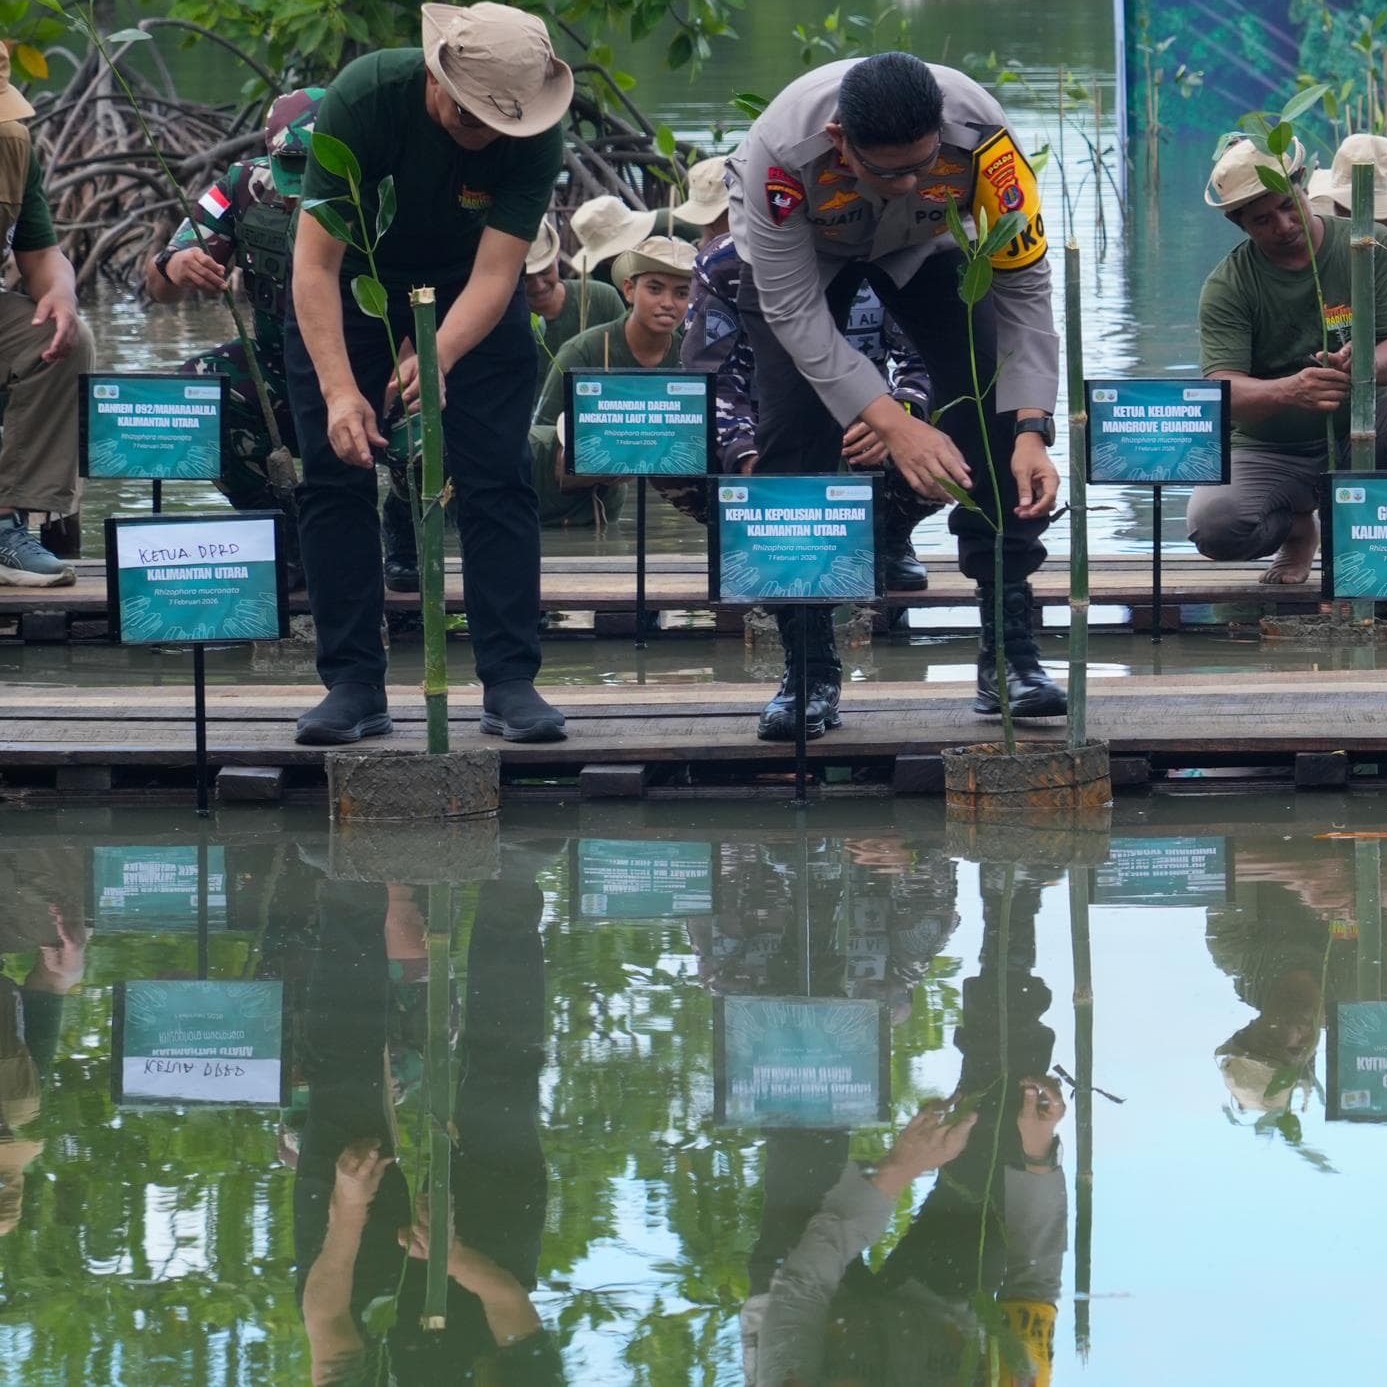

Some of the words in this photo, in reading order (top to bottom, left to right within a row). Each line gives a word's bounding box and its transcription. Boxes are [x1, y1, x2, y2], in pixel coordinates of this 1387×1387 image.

[98, 403, 133, 415] DANREM
[597, 400, 644, 411] KOMANDAN
[647, 400, 681, 411] DAERAH
[1113, 406, 1145, 417] KETUA
[1148, 406, 1202, 417] KELOMPOK
[117, 417, 170, 428] KALIMANTAN
[172, 417, 199, 428] UTARA
[579, 413, 624, 424] ANGKATAN
[625, 413, 646, 424] LAUT
[664, 414, 703, 425] TARAKAN
[1102, 421, 1158, 433] MANGROVE
[1161, 421, 1212, 433] GUARDIAN
[725, 508, 762, 521] KEPALA
[765, 508, 822, 521] KEPOLISIAN
[825, 508, 866, 520] DAERAH
[747, 525, 811, 537] KALIMANTAN
[813, 524, 847, 537] UTARA
[198, 542, 240, 558] DPRD
[752, 544, 794, 553] Rhizophora
[146, 567, 212, 581] KALIMANTAN
[215, 566, 248, 579] UTARA
[154, 587, 197, 597] Rhizophora
[198, 587, 240, 595] mucronata
